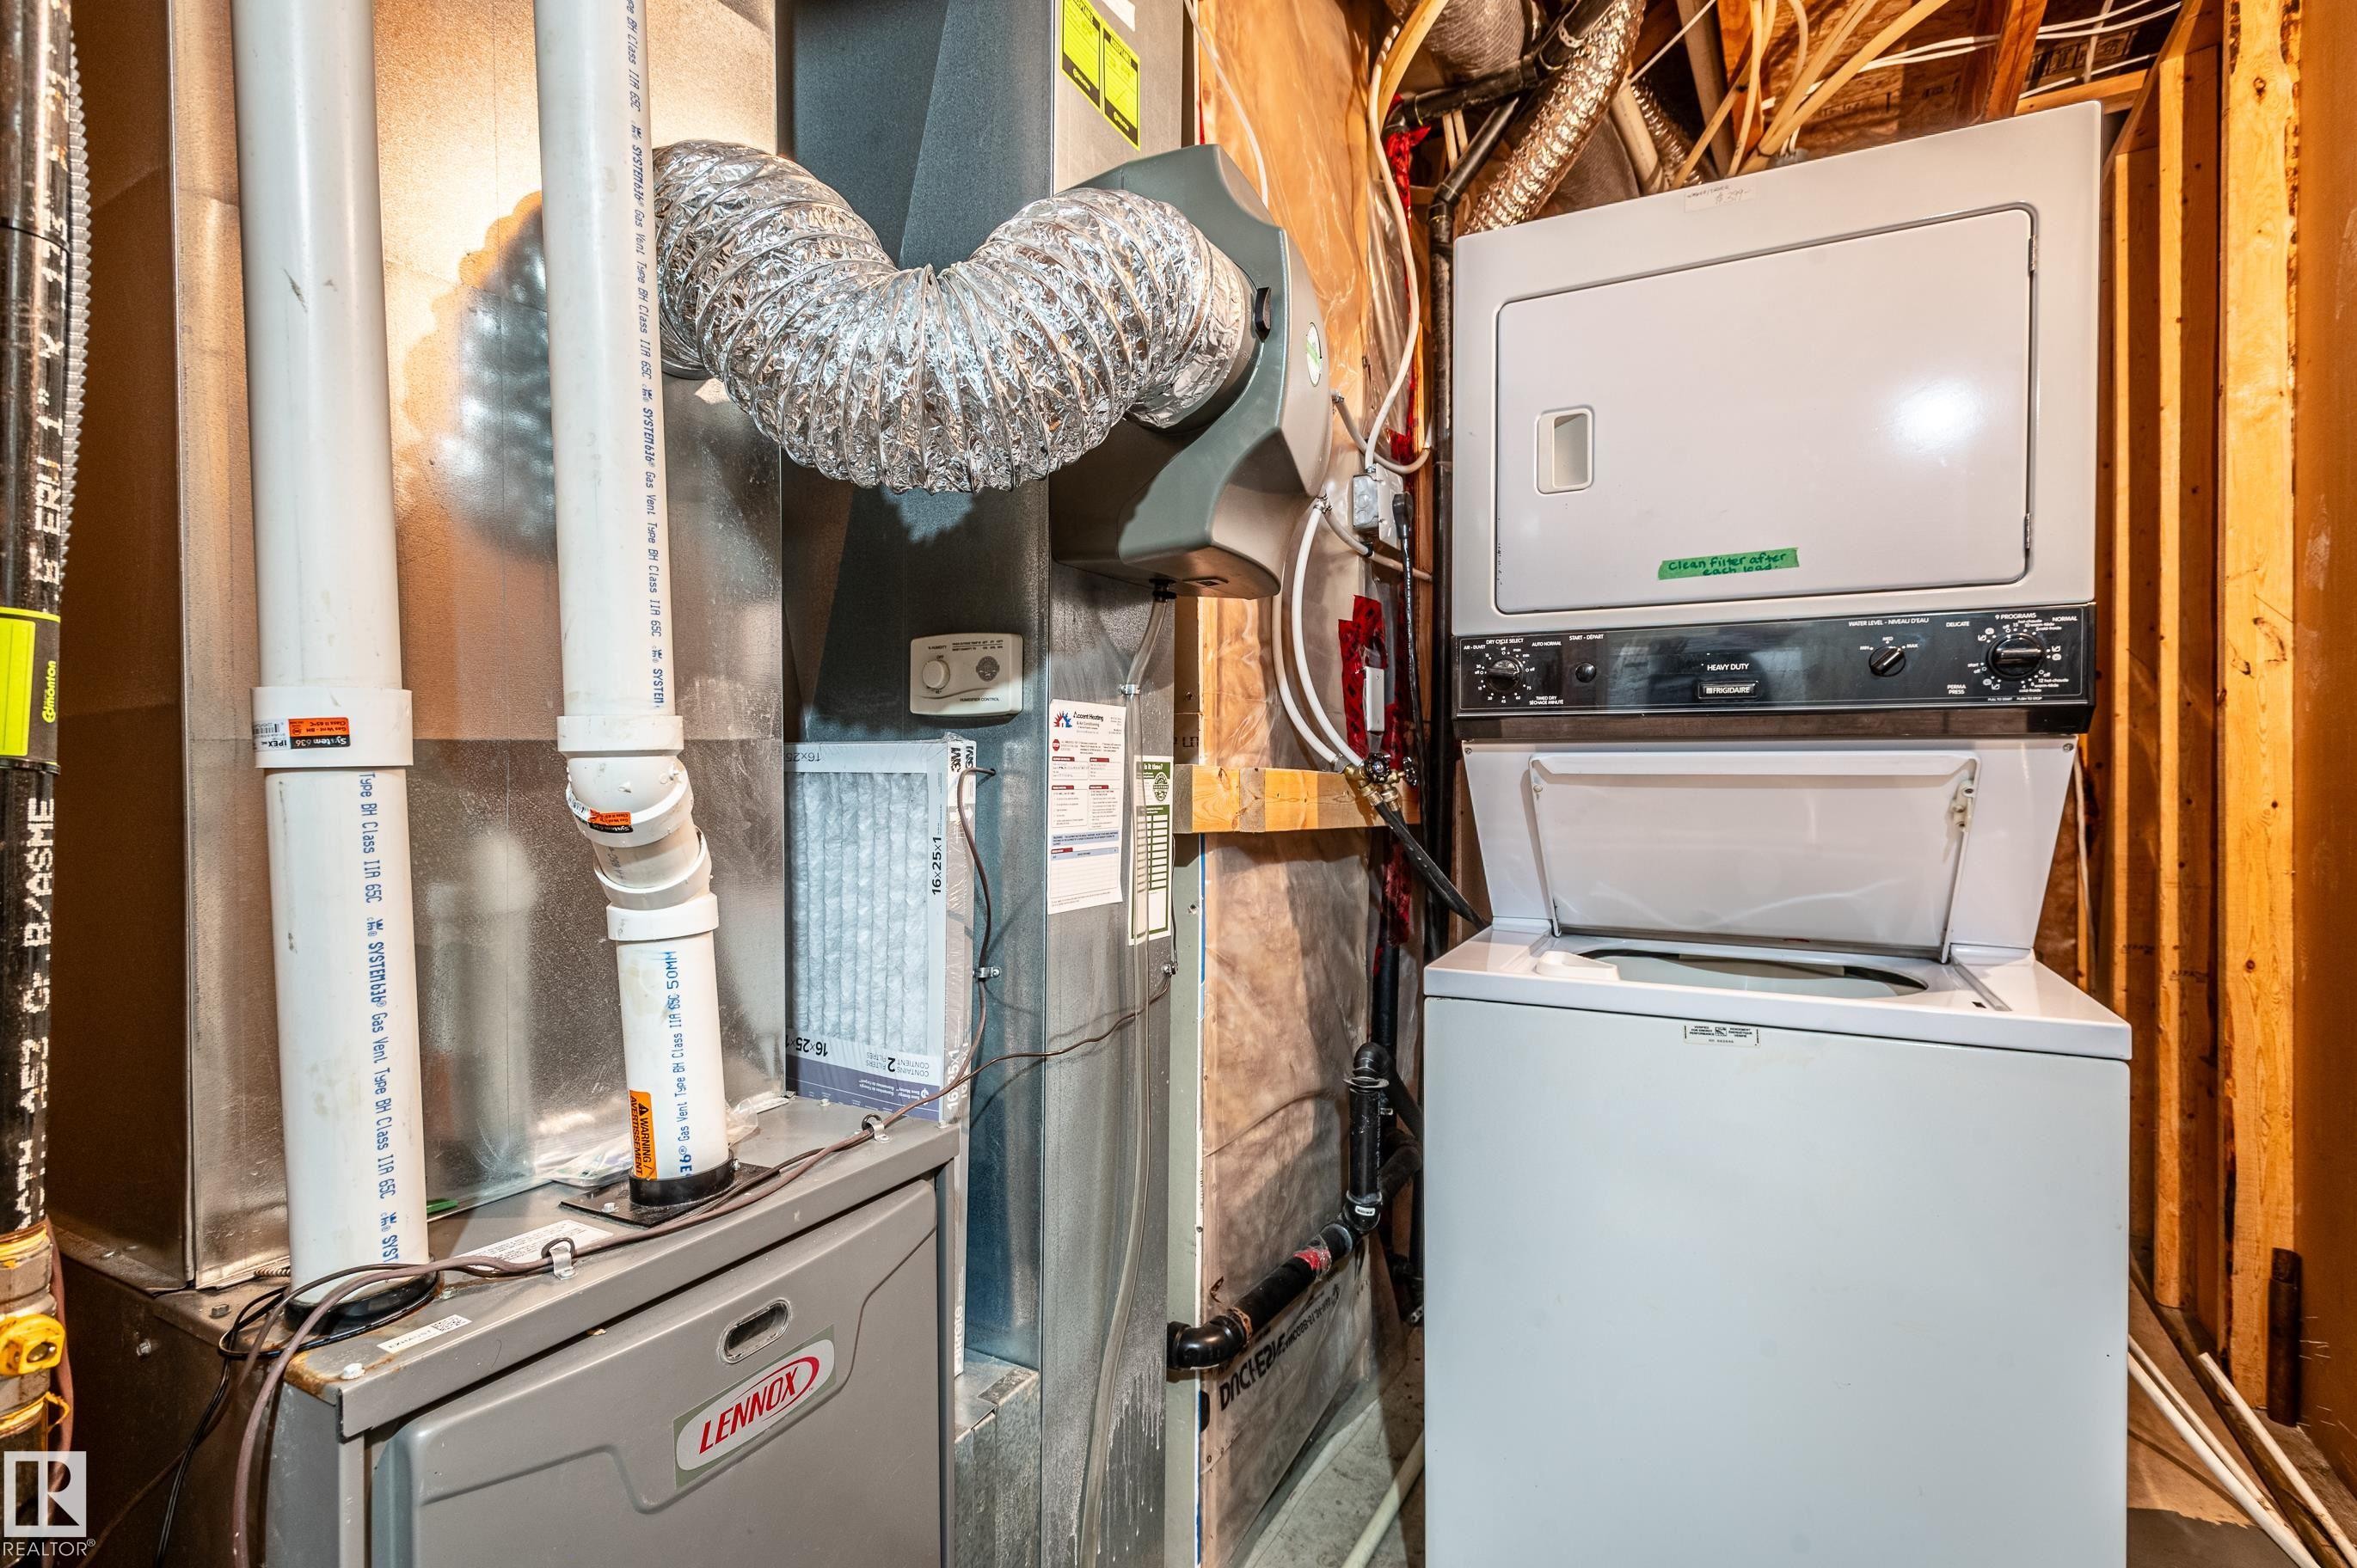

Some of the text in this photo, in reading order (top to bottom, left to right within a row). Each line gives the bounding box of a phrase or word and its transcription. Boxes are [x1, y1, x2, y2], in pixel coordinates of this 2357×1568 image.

[627, 18, 640, 112] BH Class IIA 65C
[634, 210, 651, 379] Gas Vent Type BH Class IIA 65C
[646, 471, 655, 488] Gas
[647, 494, 656, 515] Vent
[648, 523, 657, 543] Type
[648, 549, 658, 561] BH
[1668, 560, 1706, 571] Clean
[1749, 553, 1787, 565] after
[649, 566, 659, 593] Class
[1703, 566, 1736, 576] each
[650, 599, 660, 616] IIA
[651, 620, 661, 637] 65C
[42, 660, 57, 723] Edmonton
[654, 669, 664, 708] SYSTEM
[1073, 711, 1088, 720] Accent
[785, 751, 821, 762] 16x25
[359, 773, 382, 903] Type BH Class IIA 65C
[932, 835, 942, 896] 16x25x1
[371, 1012, 388, 1033] Gas
[669, 1012, 682, 1029] IIA
[372, 1037, 389, 1063] Vent
[672, 1032, 684, 1059] Class
[866, 1052, 887, 1062] FILTRES
[866, 1060, 886, 1070] FILTERS
[888, 1057, 896, 1072] 2
[897, 1059, 929, 1069] CONTIENT
[672, 1063, 685, 1074] BH
[896, 1067, 929, 1077] CONTAINS
[374, 1068, 390, 1095] Type
[675, 1077, 687, 1098] Type
[376, 1099, 391, 1113] BH
[677, 1101, 689, 1124] Vent
[376, 1117, 392, 1150] Class
[629, 1095, 643, 1177] AVERTISSEMENT
[639, 1117, 652, 1163] WARNING
[678, 1125, 690, 1142] Gas
[377, 1154, 394, 1174] IIA
[379, 1179, 395, 1199] 65C
[699, 1366, 799, 1455] LENNOX
